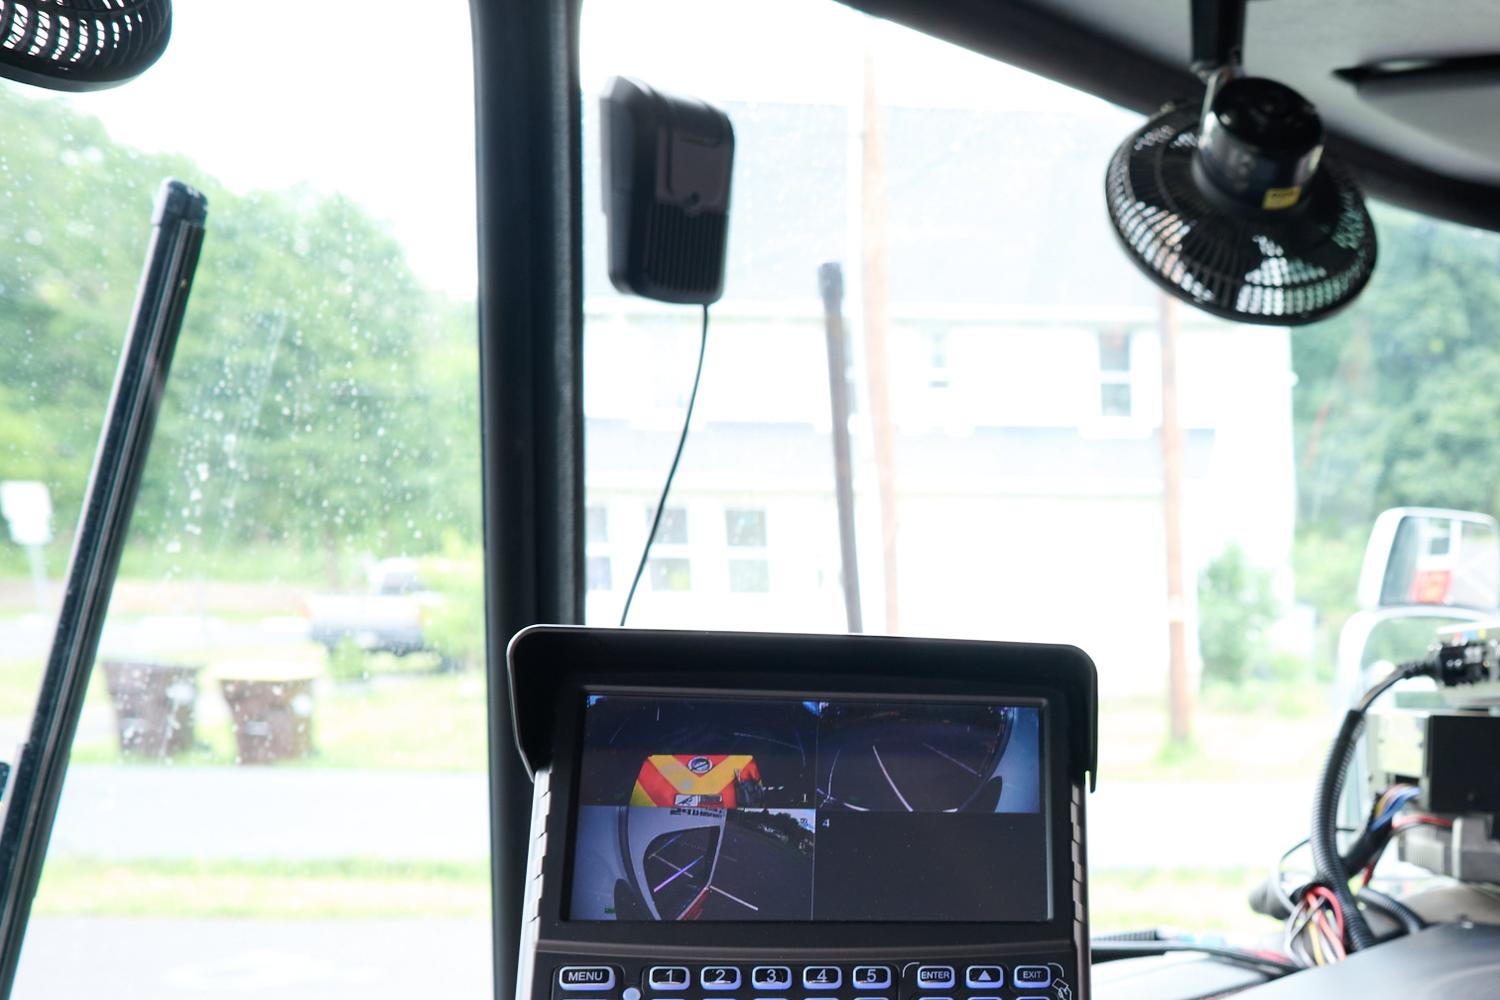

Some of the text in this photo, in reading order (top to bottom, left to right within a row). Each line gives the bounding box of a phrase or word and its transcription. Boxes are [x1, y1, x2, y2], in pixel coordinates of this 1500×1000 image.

[822, 818, 830, 828] 4
[568, 971, 603, 982] MENU
[666, 969, 877, 983] 1 2 3 4 5
[921, 971, 950, 980] ENTER
[1023, 970, 1041, 979] EXIT
